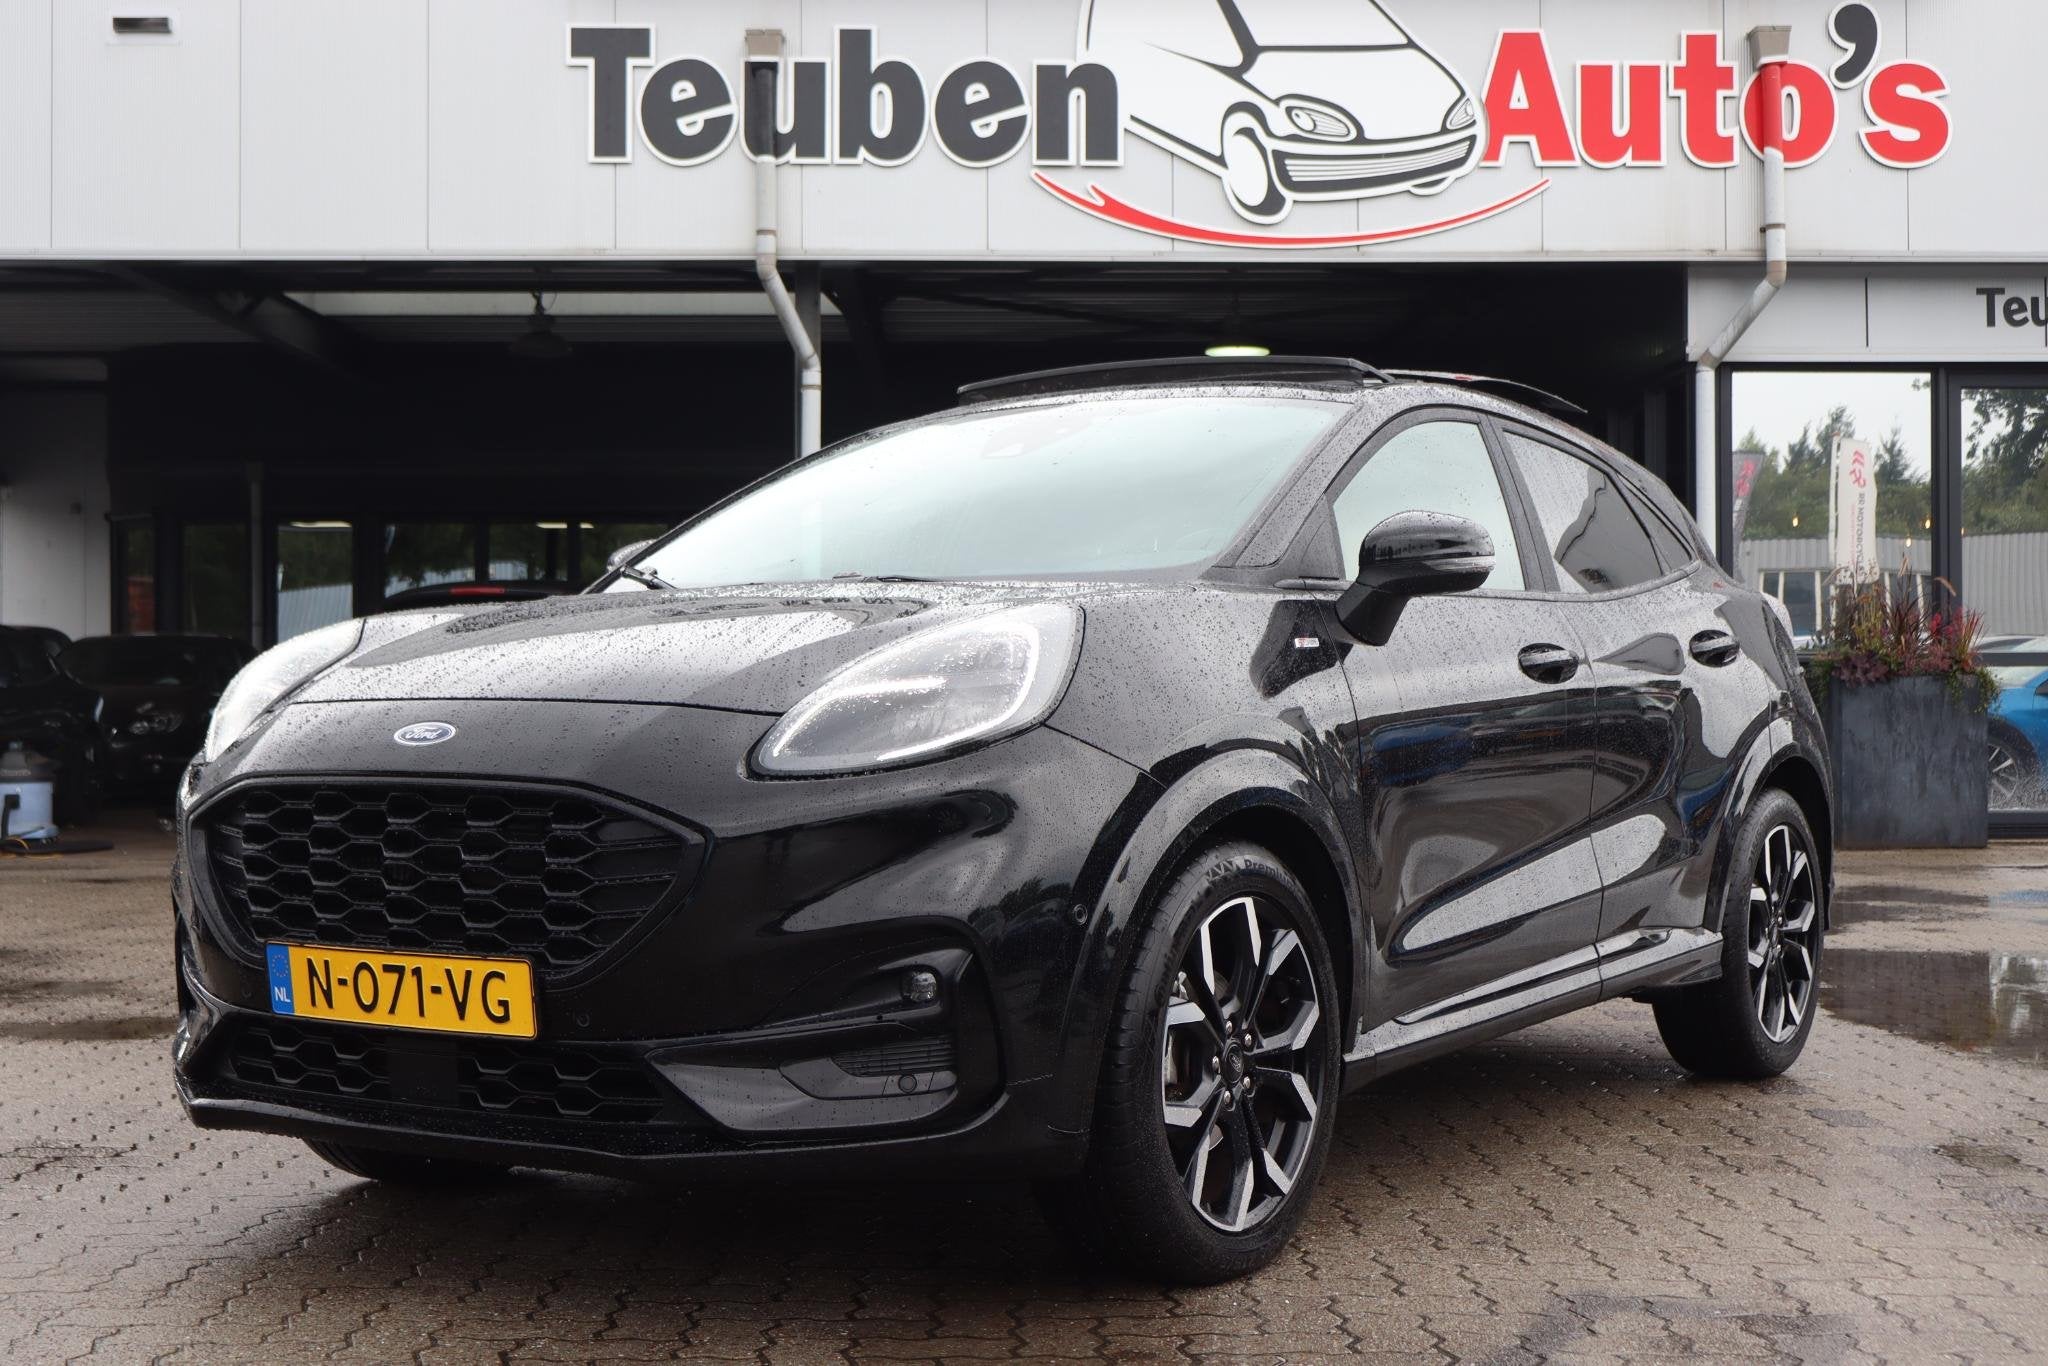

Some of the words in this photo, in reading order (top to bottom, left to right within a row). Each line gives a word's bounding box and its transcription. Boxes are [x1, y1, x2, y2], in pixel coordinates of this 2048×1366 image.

[568, 26, 1121, 166] Teuben
[1481, 3, 1951, 167] Auto's
[274, 985, 291, 1003] NL
[306, 957, 511, 1024] N-071-VG
